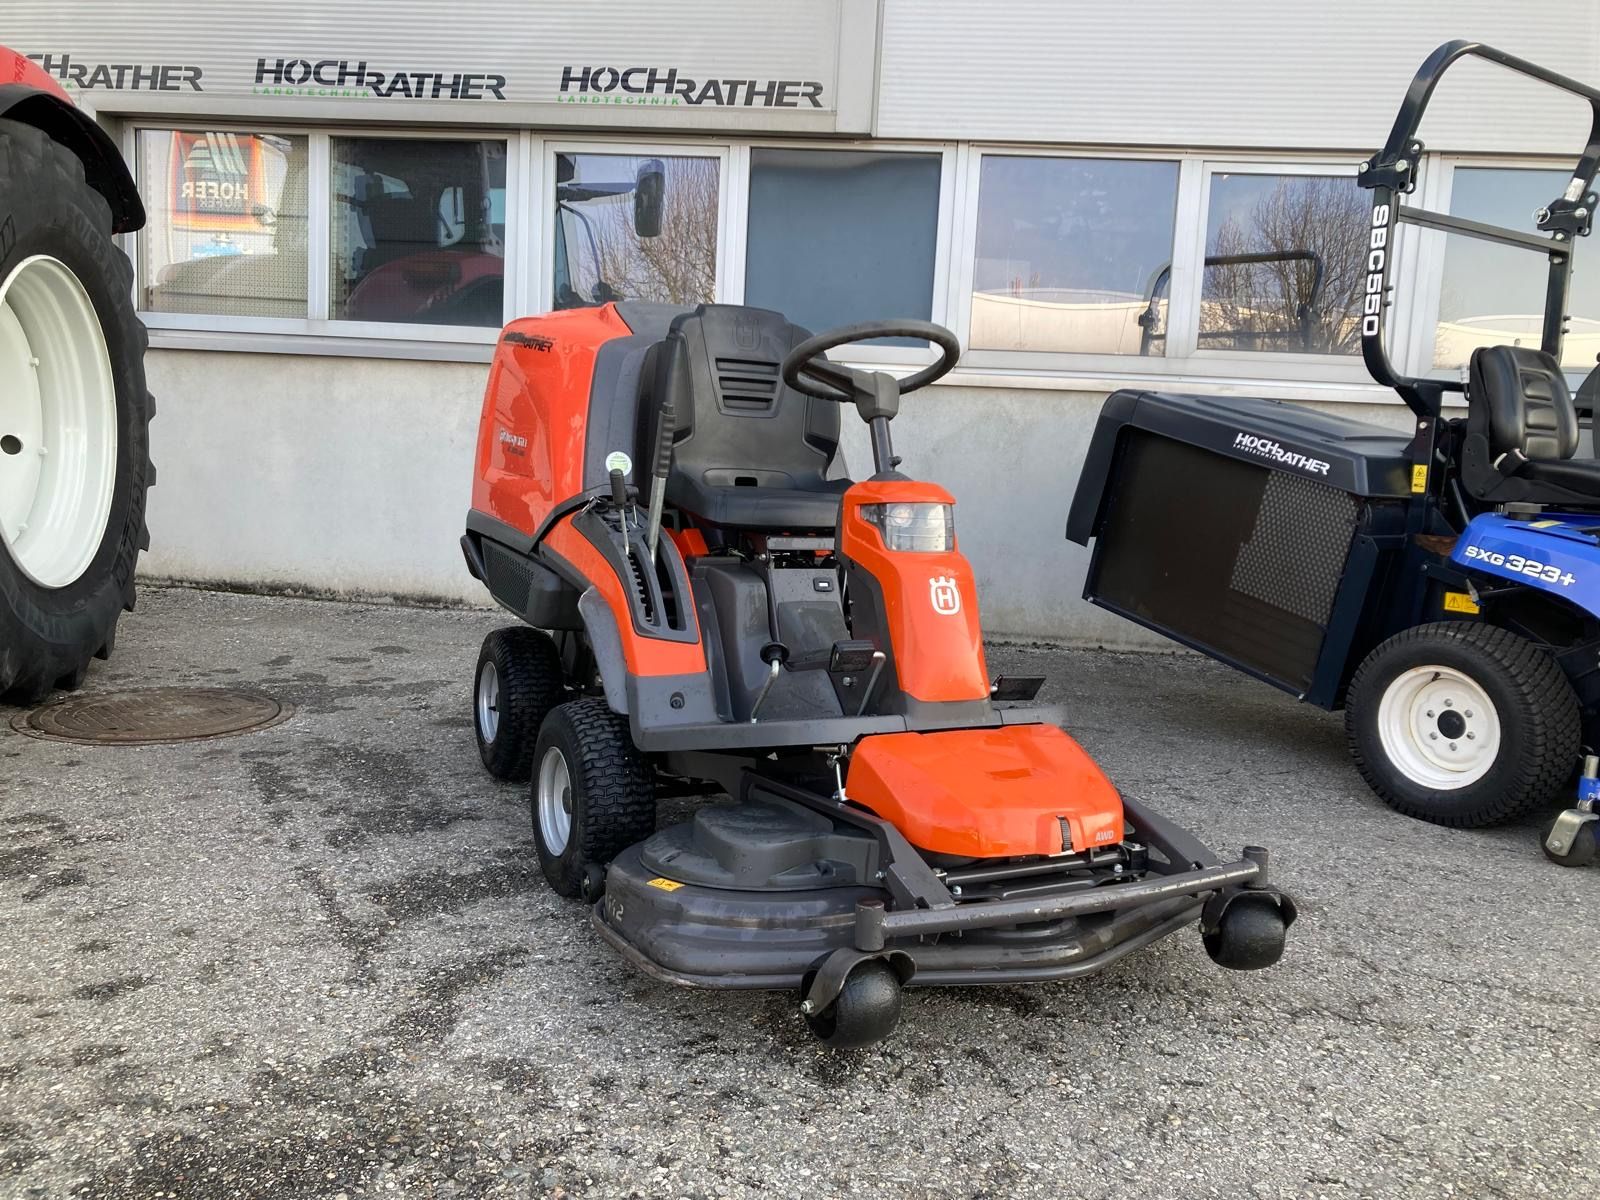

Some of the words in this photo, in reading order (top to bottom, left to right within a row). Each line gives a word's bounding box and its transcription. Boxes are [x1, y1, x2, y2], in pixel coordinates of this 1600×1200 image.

[252, 86, 369, 98] LANDTECHNIK
[254, 58, 507, 101] HOCHRATHER
[557, 94, 680, 105] LANDTECHNIK
[559, 66, 824, 108] HOCHRATHER
[1362, 204, 1390, 337] SBC550
[1234, 432, 1331, 476] HOCHRATHER
[1464, 545, 1506, 566] SXG
[1505, 554, 1576, 586] 323+
[1095, 830, 1115, 843] AWD
